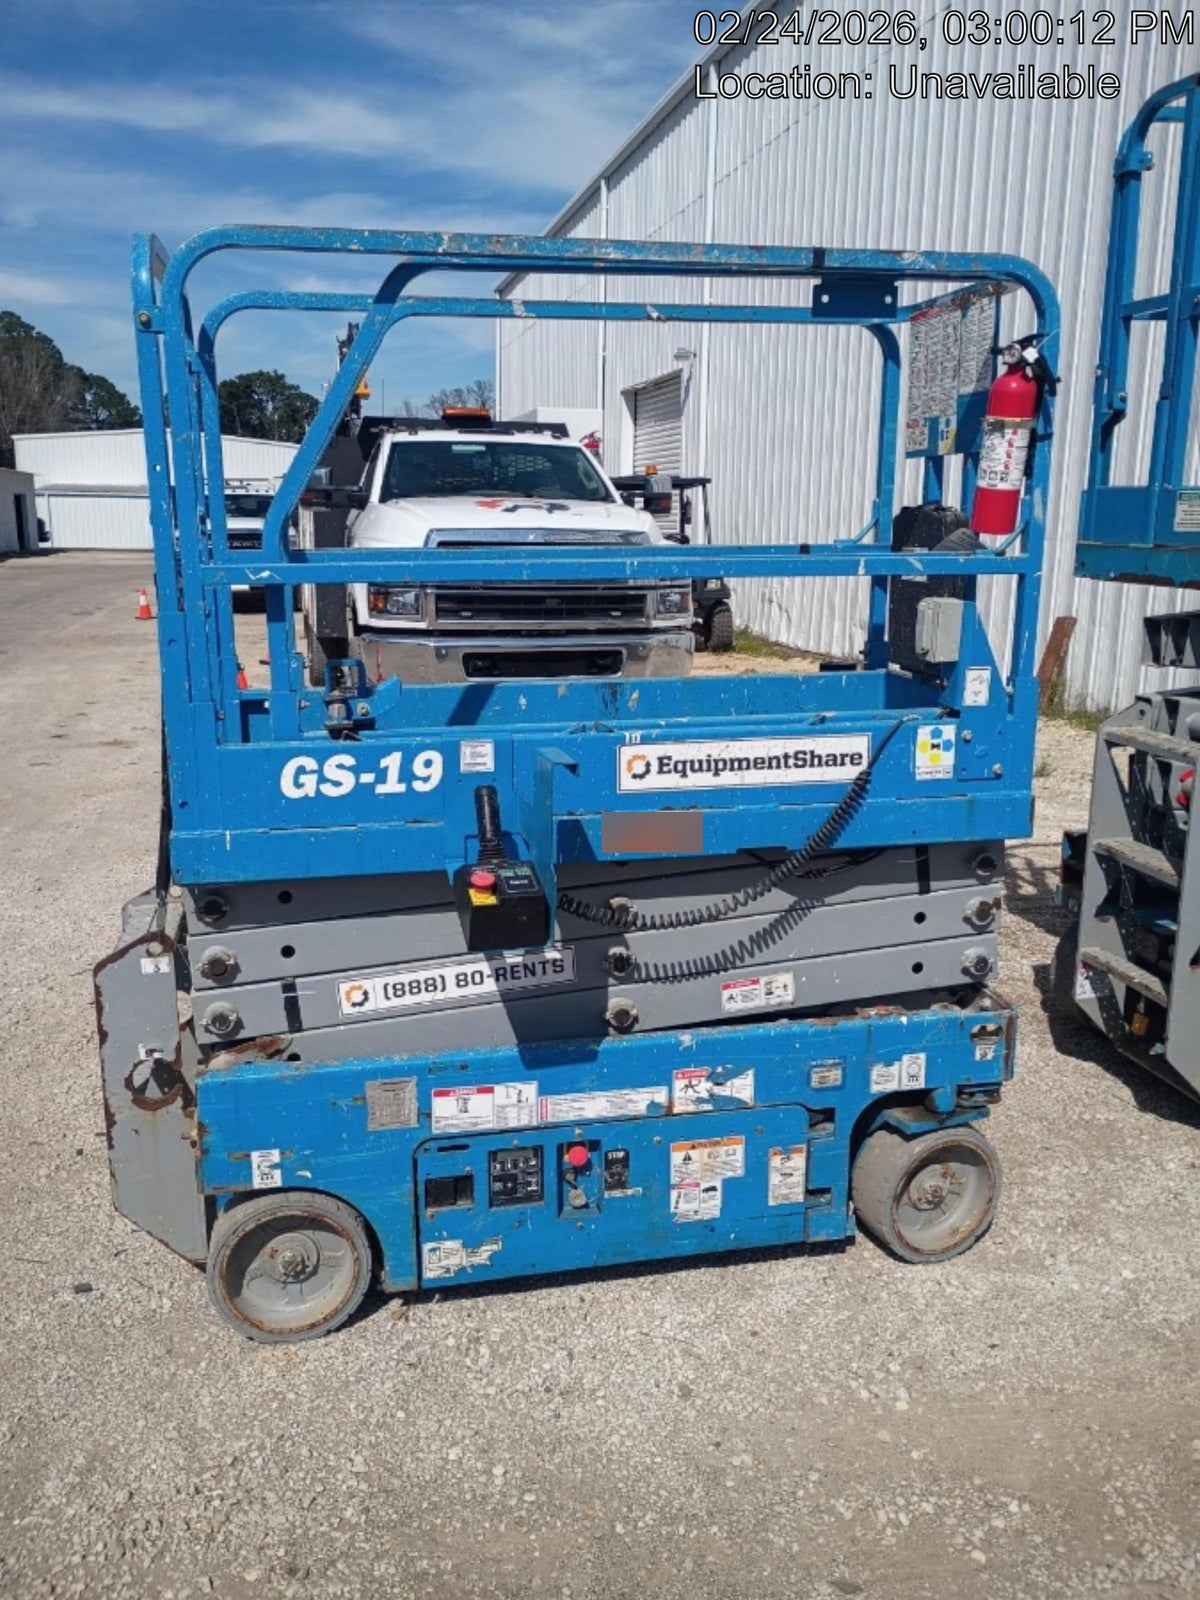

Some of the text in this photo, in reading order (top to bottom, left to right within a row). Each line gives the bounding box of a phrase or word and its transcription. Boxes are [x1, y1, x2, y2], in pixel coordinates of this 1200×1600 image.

[280, 750, 444, 799] GS-19
[656, 750, 864, 778] EquipmentShare
[383, 958, 565, 1001] (888) 80-RENTS
